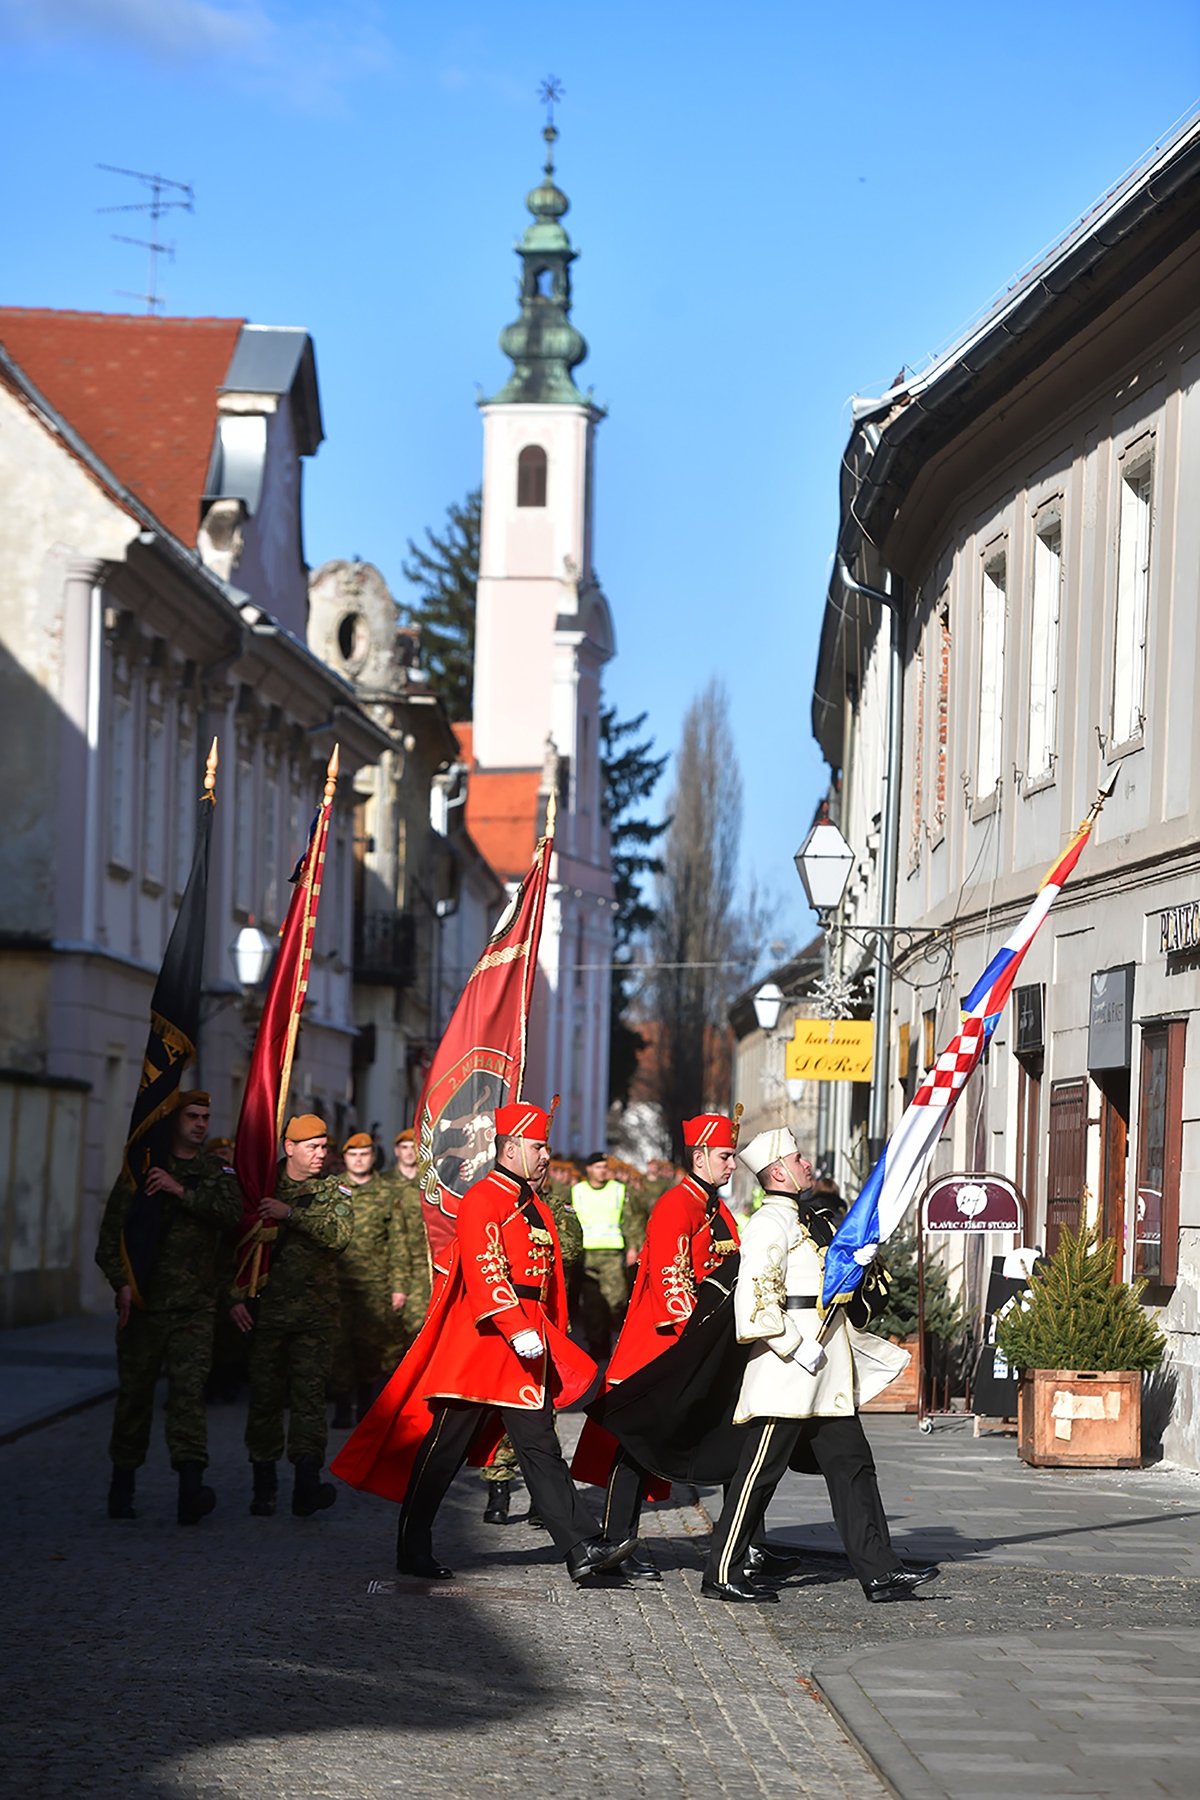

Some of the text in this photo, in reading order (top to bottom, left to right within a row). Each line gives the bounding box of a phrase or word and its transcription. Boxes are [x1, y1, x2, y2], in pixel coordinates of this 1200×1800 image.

[795, 1053, 873, 1073] DORA
[448, 1077, 462, 1091] 2.
[987, 1220, 1017, 1230] STUDIO
